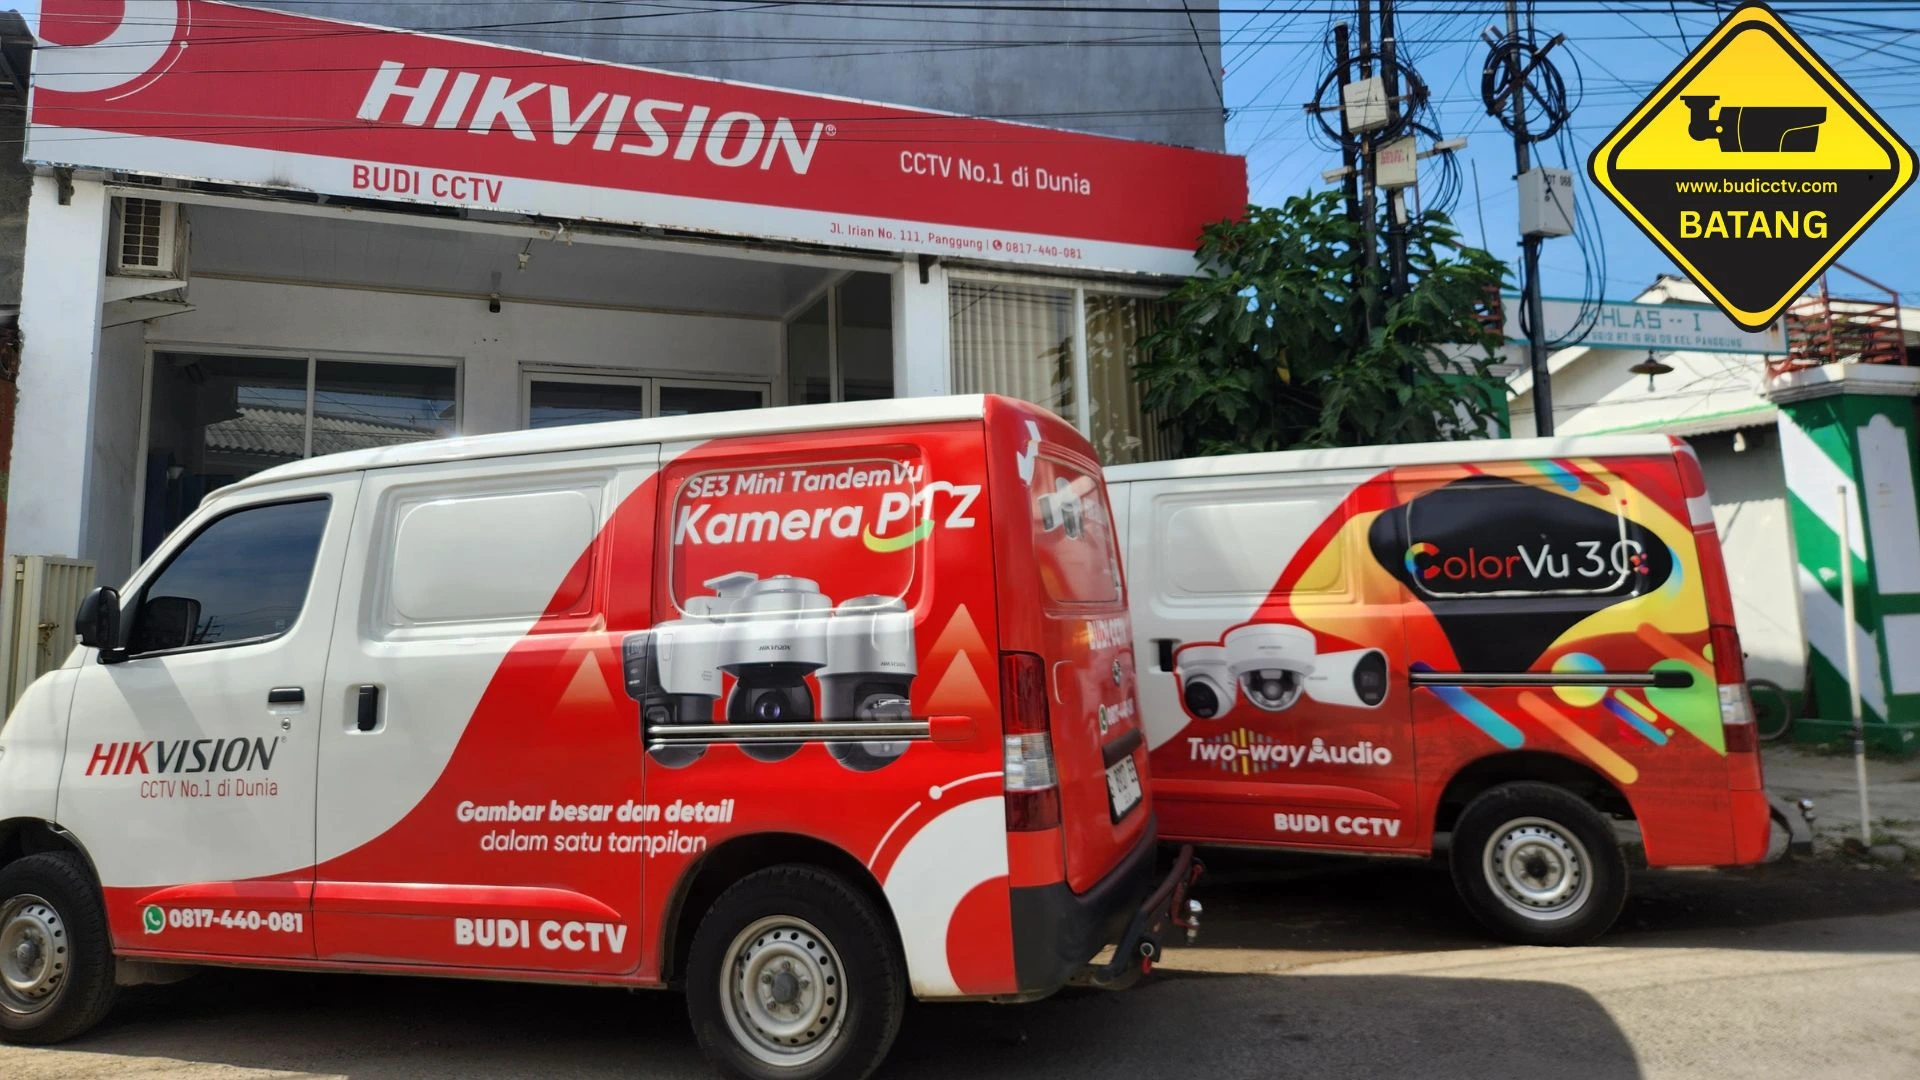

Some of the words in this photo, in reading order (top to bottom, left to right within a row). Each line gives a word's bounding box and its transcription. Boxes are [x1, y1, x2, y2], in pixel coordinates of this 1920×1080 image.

[353, 165, 419, 194] BUDI
[432, 174, 503, 203] CCTV
[900, 151, 952, 178] CCTV
[959, 158, 1003, 185] No.1
[1011, 166, 1029, 188] di
[1036, 168, 1091, 195] Dunia
[848, 224, 874, 238] Irian
[878, 228, 896, 240] No.
[928, 232, 982, 251] Panggung
[1006, 242, 1082, 259] 0817-440-081
[687, 475, 730, 498] SE3
[734, 470, 783, 496] Mini
[791, 460, 924, 492] TandemVu
[674, 504, 863, 545] Kamera
[1404, 542, 1570, 580] ColorVu
[1187, 738, 1305, 767] Two-way
[1307, 738, 1392, 766] Audio
[141, 780, 176, 799] CCTV
[180, 777, 211, 798] No.1
[217, 779, 230, 797] di
[236, 778, 278, 797] Dunia
[456, 800, 545, 822] Gambar
[550, 799, 613, 822] besar
[616, 800, 660, 822] dan
[665, 799, 735, 822] detail
[1274, 813, 1329, 833] BUDI
[1335, 815, 1401, 837] CCTV
[480, 829, 548, 851] dalam
[554, 832, 601, 852] satu
[608, 829, 707, 858] tampilan
[169, 908, 303, 933] 0817-440-081
[455, 918, 530, 948] BUDI
[538, 920, 627, 953] CCTV
